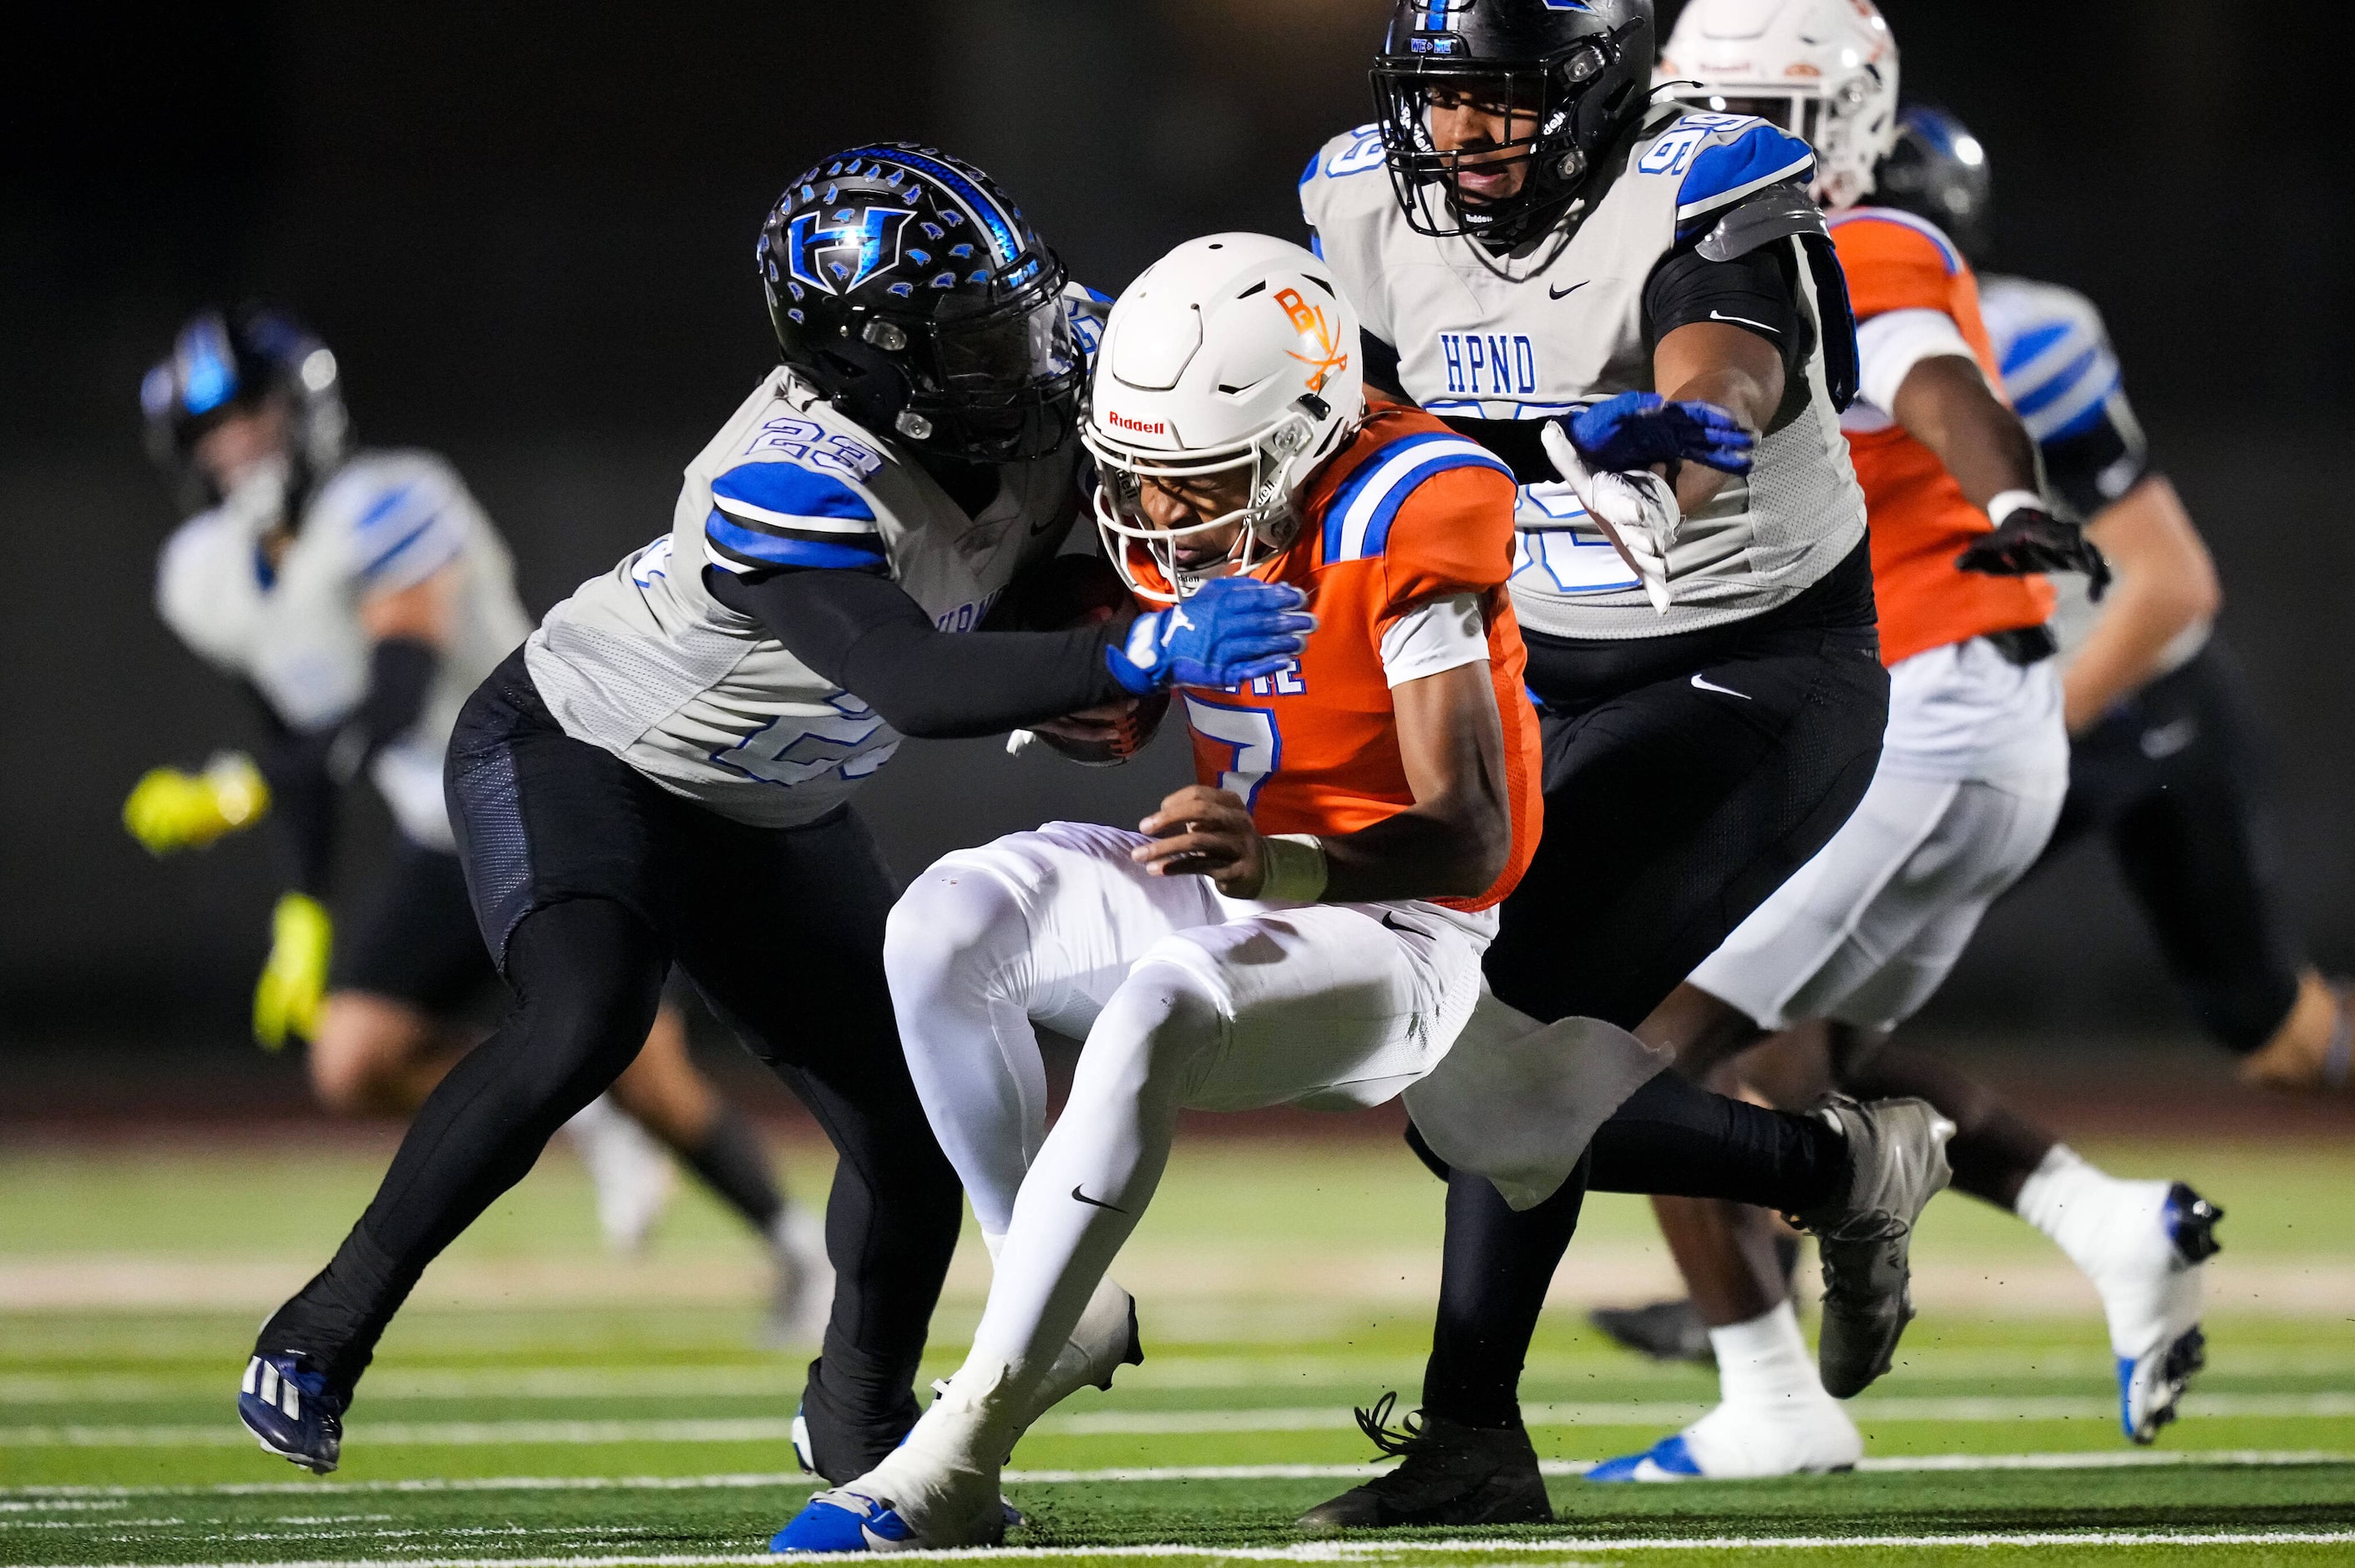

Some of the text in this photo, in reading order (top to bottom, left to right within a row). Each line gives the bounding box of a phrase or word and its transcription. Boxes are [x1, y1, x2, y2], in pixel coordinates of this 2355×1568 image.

[1638, 113, 1763, 175] 99
[1438, 332, 1537, 396] HPND
[743, 417, 884, 484] 23
[1109, 411, 1164, 434] Riddell
